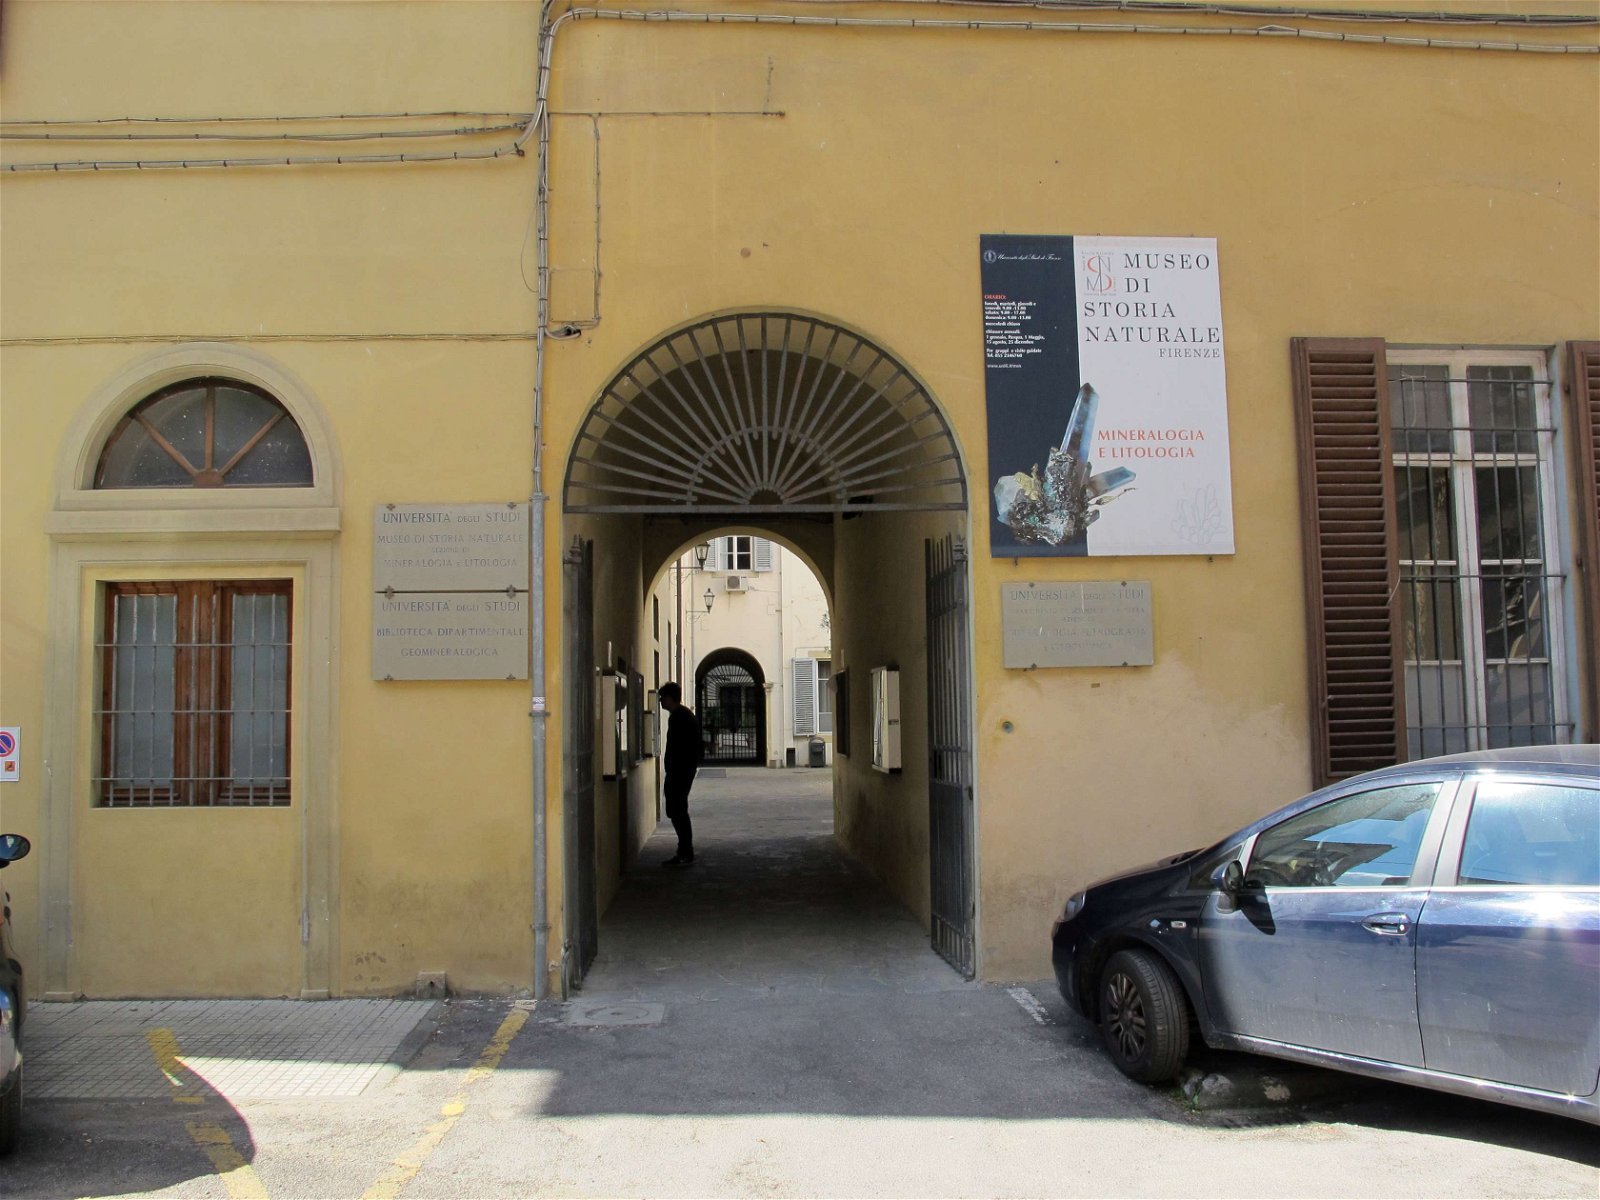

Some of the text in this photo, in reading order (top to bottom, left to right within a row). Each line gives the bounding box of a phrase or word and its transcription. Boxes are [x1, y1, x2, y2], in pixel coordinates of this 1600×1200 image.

[1124, 253, 1210, 270] MUSEO
[1125, 277, 1151, 293] DI
[1084, 302, 1176, 318] STORIA
[1085, 326, 1220, 343] NATURALE
[1159, 348, 1220, 358] FIRENZE
[1097, 429, 1205, 441] MINERALOGIA
[1098, 447, 1195, 458] E LITOLOGIA
[457, 515, 480, 523] DEGLI
[486, 512, 520, 523] STUDI
[377, 533, 523, 544] MUSEO DI STORIA NATURALE
[383, 559, 453, 568] MINERALOGIA
[464, 558, 517, 568] LITOLOGIA
[485, 601, 520, 611] STUDI
[376, 627, 433, 637] BIBLIOTECA
[400, 647, 498, 657] GEOMINERALOGICA
